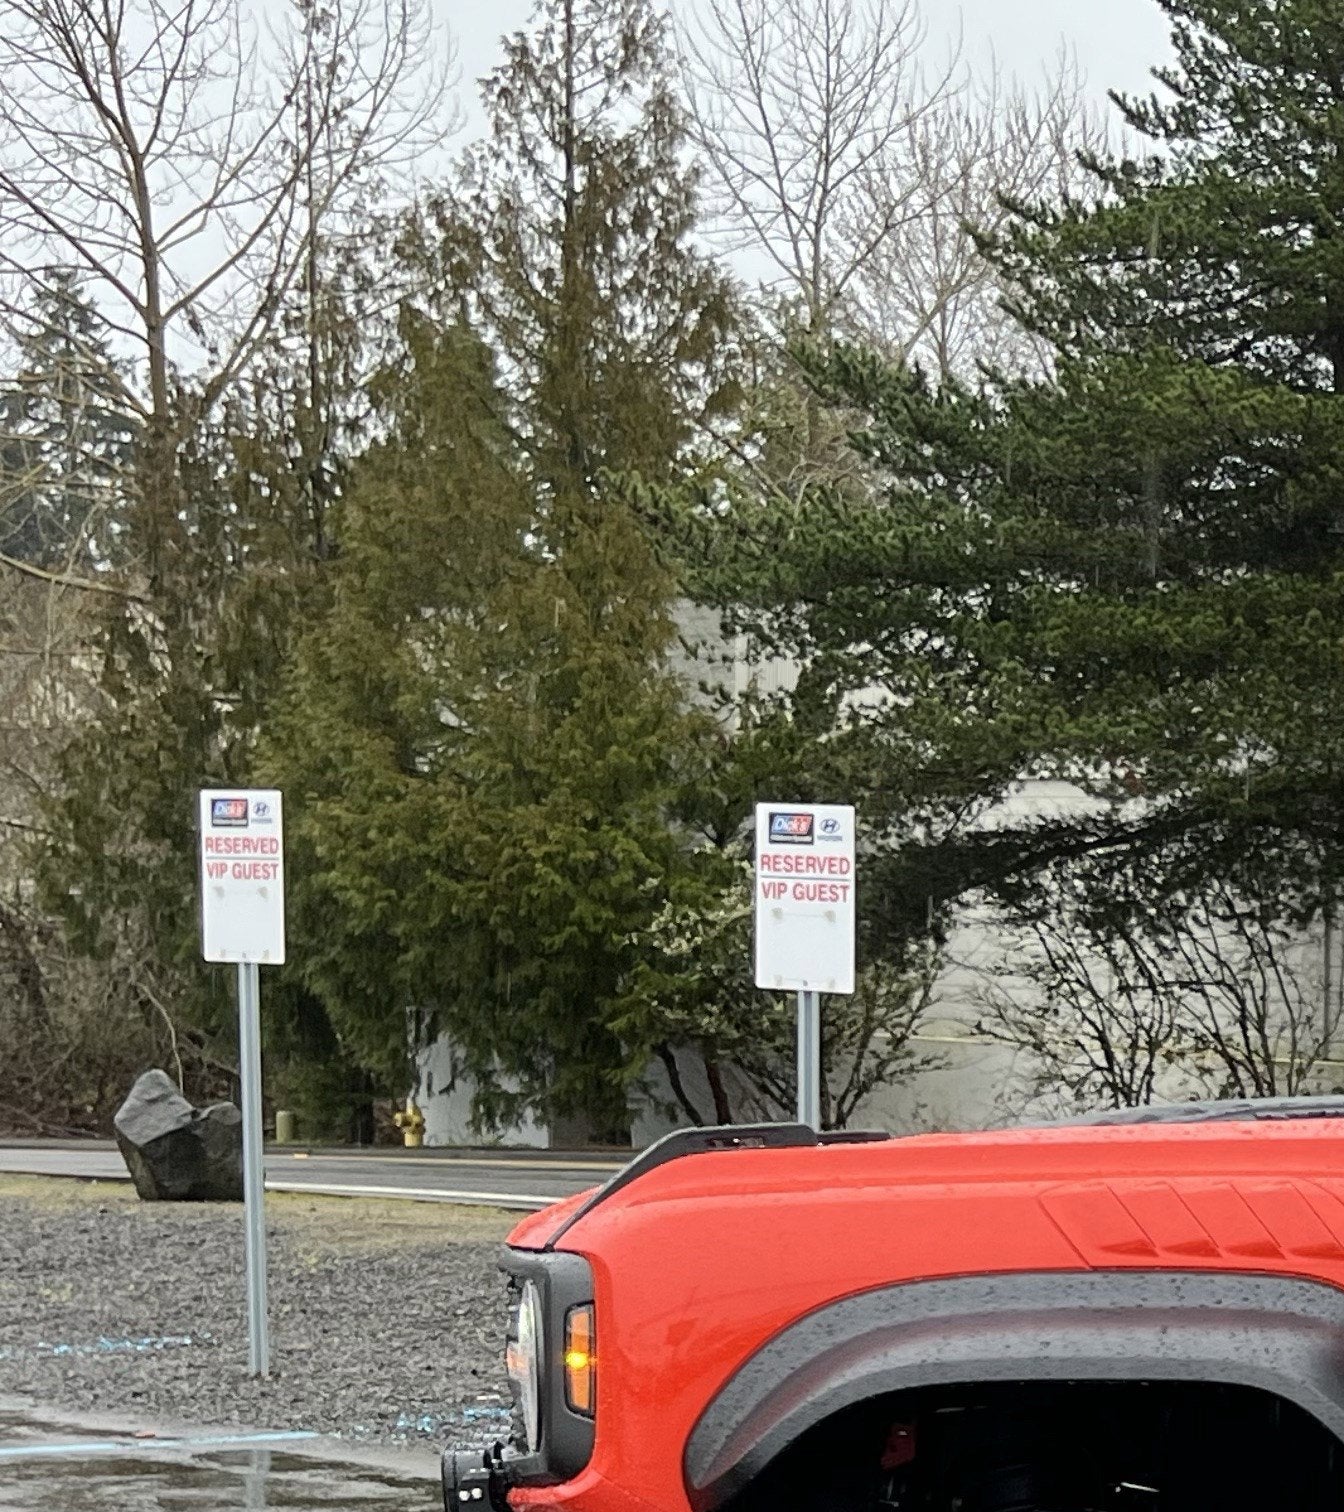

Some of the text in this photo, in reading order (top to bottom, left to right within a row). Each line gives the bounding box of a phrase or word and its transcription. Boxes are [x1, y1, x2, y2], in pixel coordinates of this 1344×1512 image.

[205, 837, 279, 854] RESERVED
[207, 863, 279, 880] VIP GUEST
[761, 854, 850, 875] RESERVED
[761, 882, 850, 903] VIP GUEST
